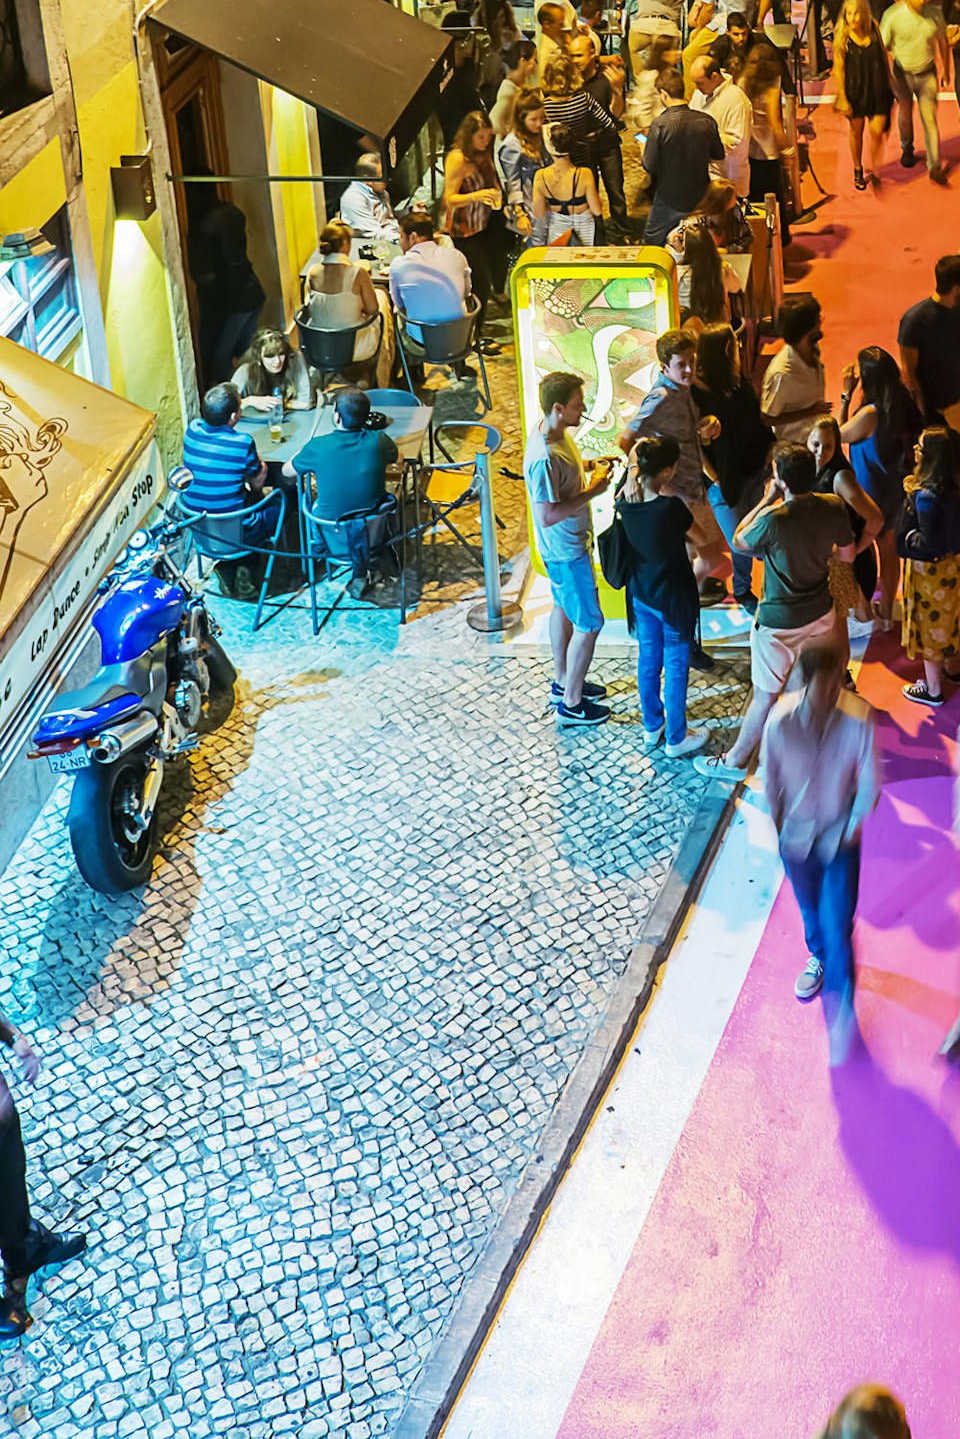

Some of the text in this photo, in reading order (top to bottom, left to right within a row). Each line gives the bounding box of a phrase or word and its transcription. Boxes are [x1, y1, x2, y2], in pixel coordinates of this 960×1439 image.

[31, 629, 48, 662] Lap
[52, 580, 80, 631] Dance
[132, 474, 153, 508] Stop
